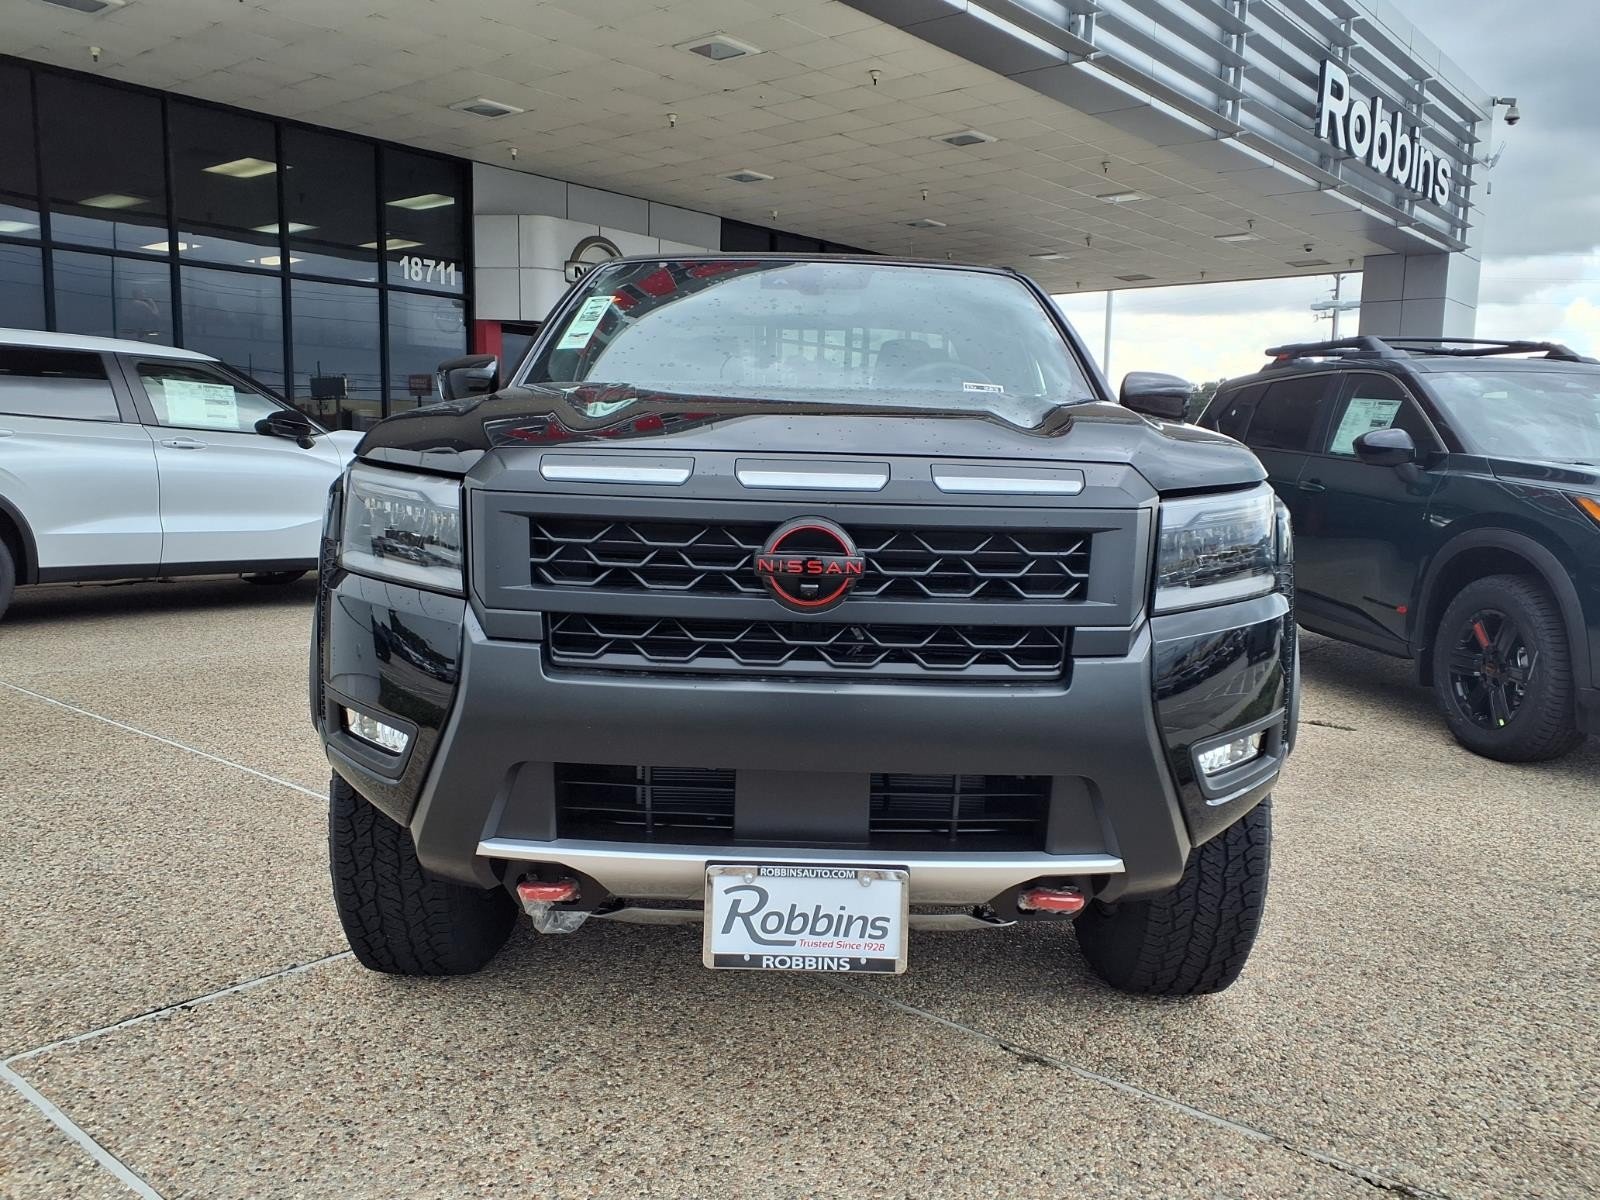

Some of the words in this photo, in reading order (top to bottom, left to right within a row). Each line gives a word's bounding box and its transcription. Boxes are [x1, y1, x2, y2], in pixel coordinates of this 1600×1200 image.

[1316, 59, 1452, 206] Robbins
[399, 255, 456, 286] 18711
[758, 558, 862, 574] NISSAN
[760, 867, 856, 880] ROBBINSAUTO.COM
[720, 884, 891, 947] Robbins
[799, 938, 834, 949] Trusted
[835, 940, 861, 951] Since
[863, 942, 886, 952] 1928
[761, 955, 850, 971] ROBBINS
